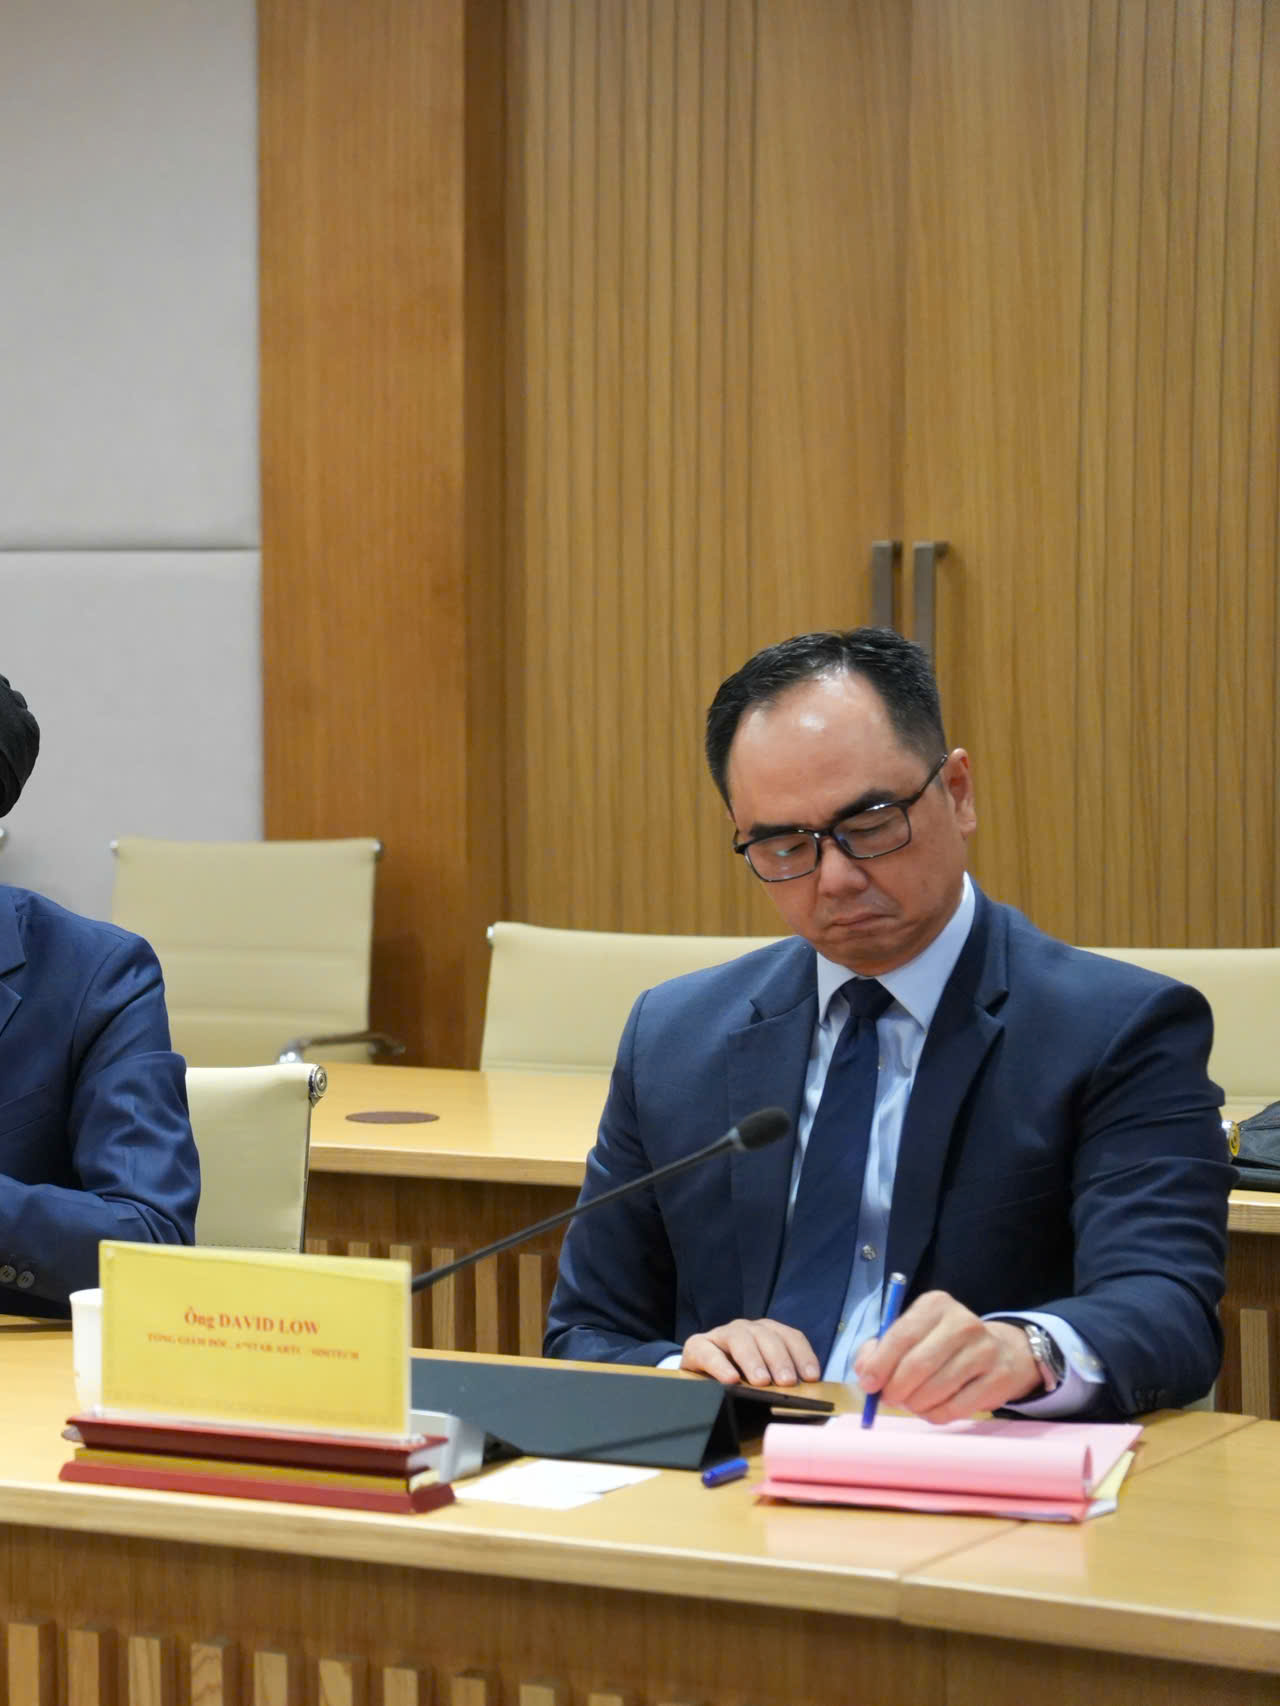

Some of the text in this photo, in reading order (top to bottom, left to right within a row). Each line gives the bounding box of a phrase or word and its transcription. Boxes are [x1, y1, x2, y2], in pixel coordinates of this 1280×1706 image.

[184, 1305, 318, 1335] Ông DAVID LOW
